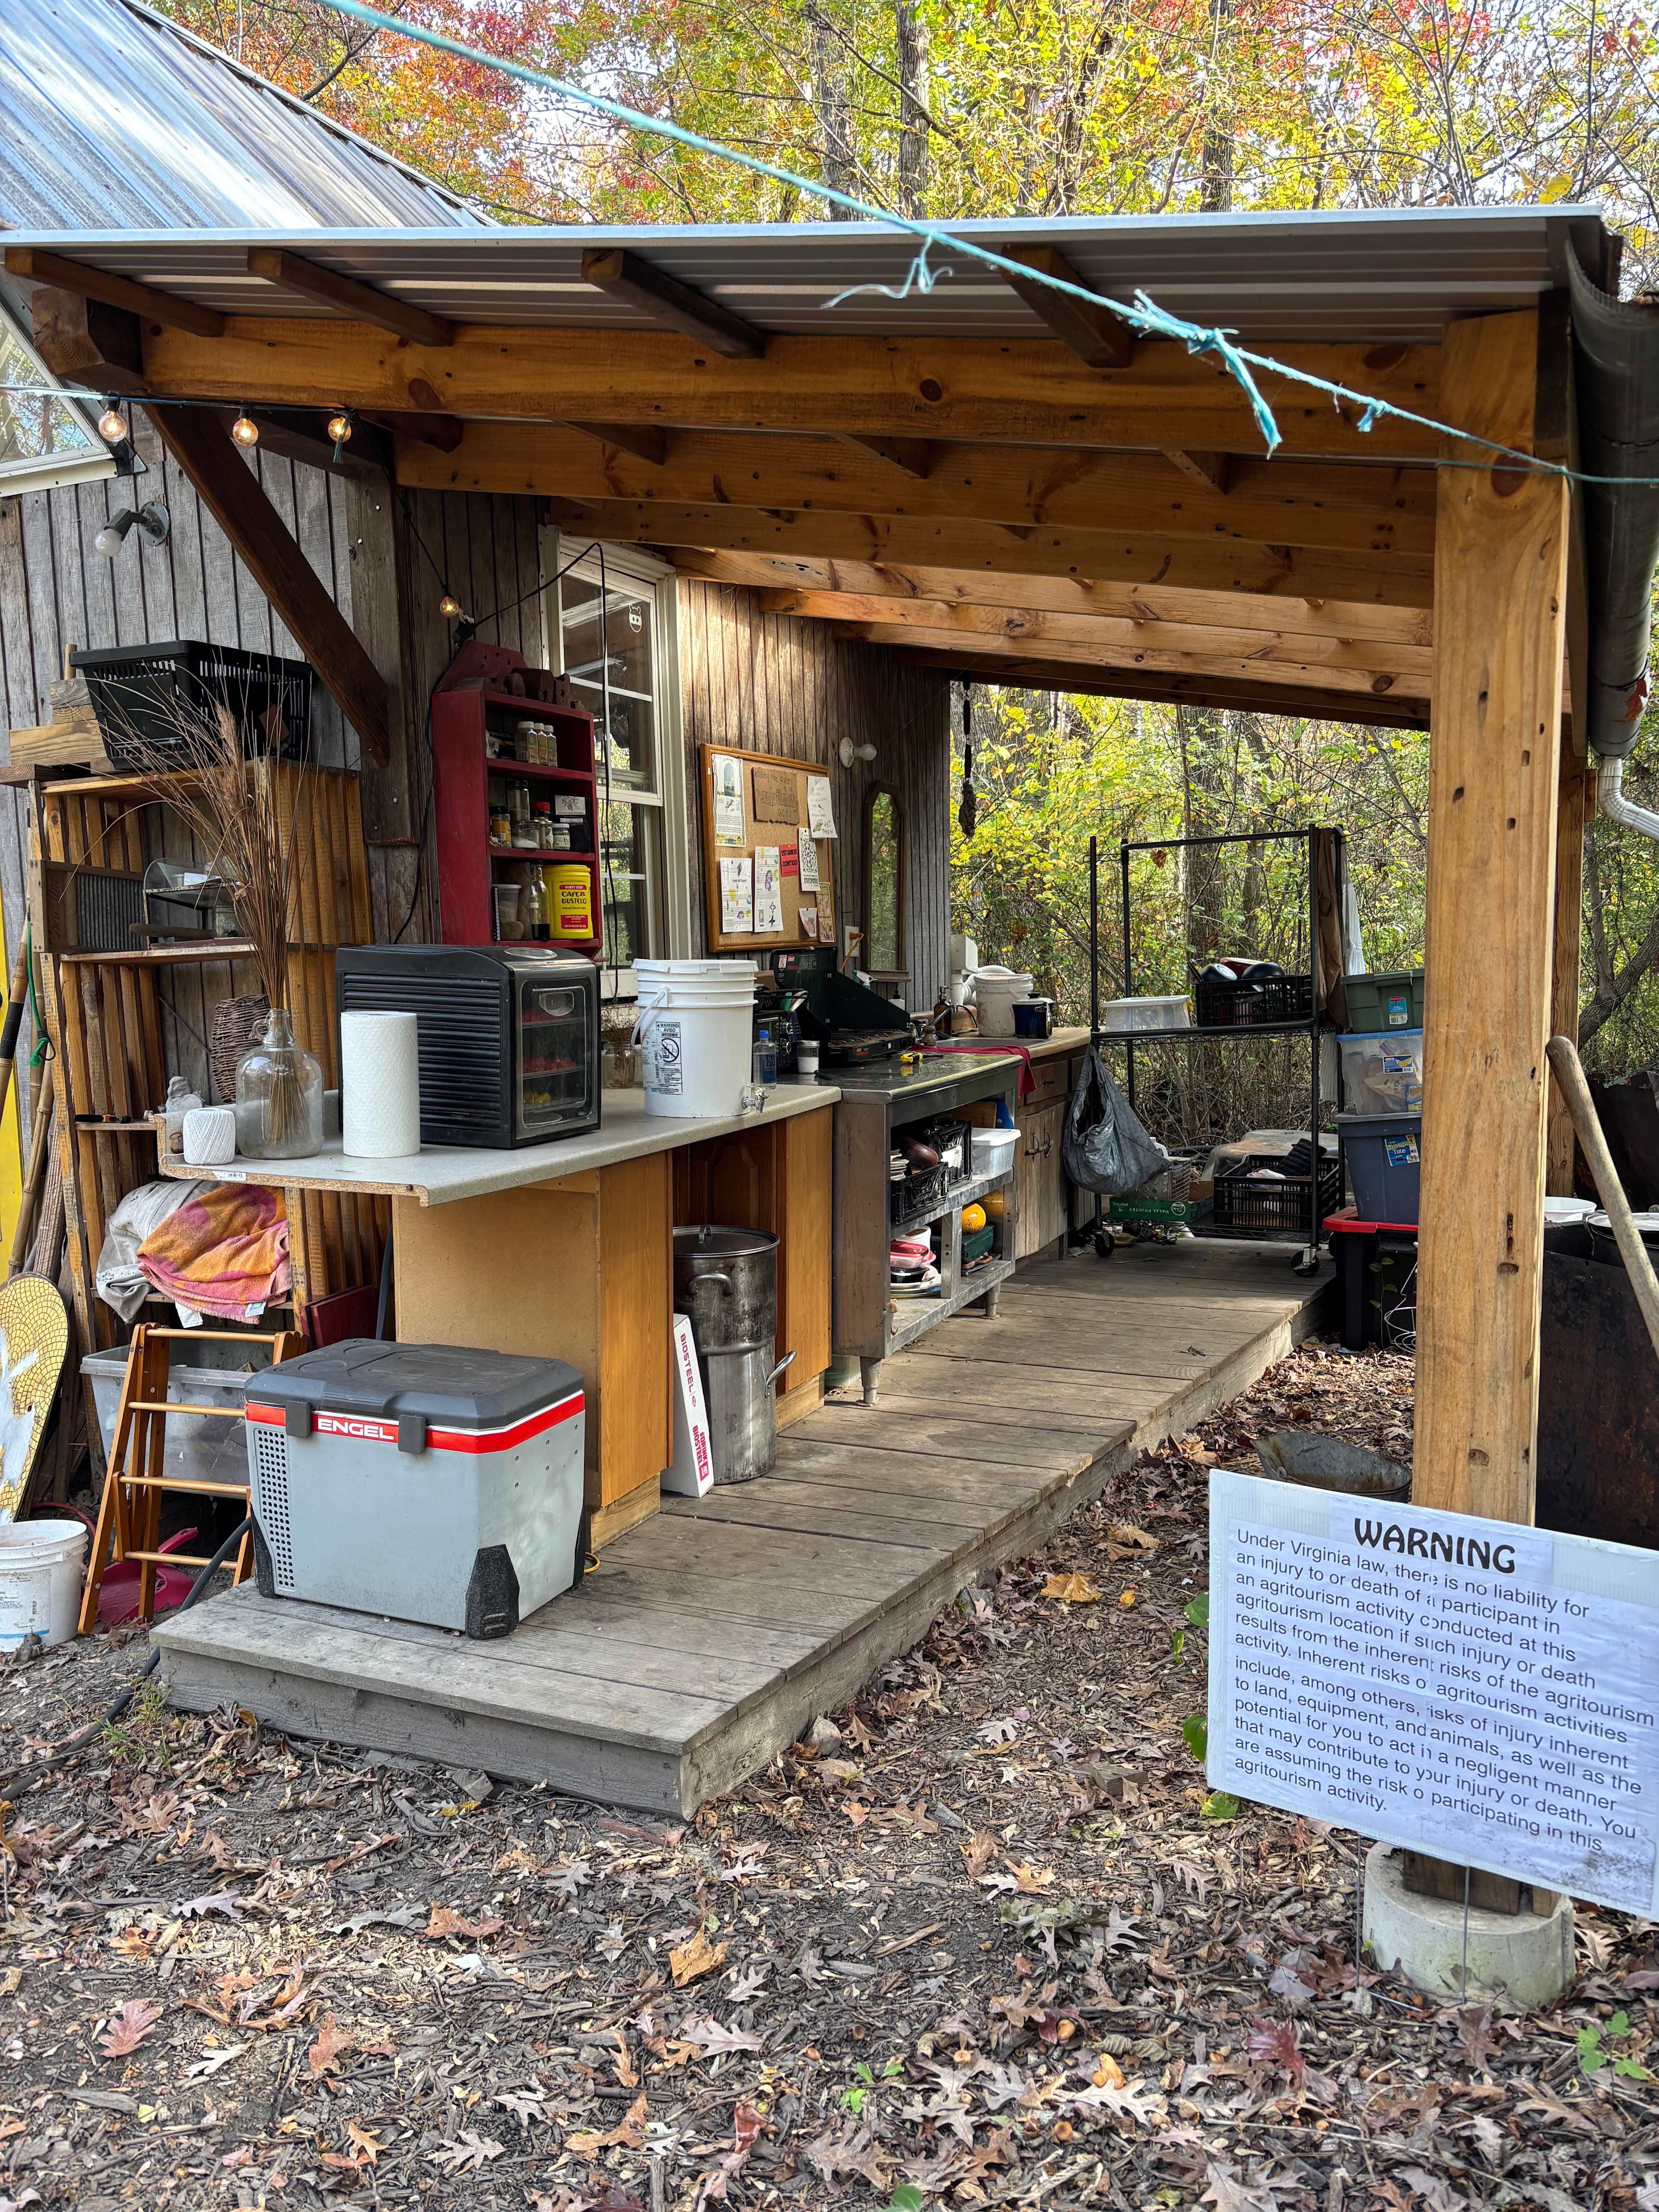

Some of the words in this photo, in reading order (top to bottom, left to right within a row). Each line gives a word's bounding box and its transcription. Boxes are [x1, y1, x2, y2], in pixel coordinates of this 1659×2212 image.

[680, 1333, 694, 1393] BIOSTEEL
[318, 1417, 394, 1440] ENGEL
[693, 1424, 702, 1467] BIOSTEEL
[699, 1432, 708, 1462] #DRINK
[1238, 1529, 1285, 1551] Under
[1290, 1540, 1351, 1567] Virginia
[1357, 1554, 1388, 1577] law,
[1445, 1573, 1458, 1590] is
[1465, 1581, 1487, 1595] no
[1494, 1584, 1558, 1614] liability
[1564, 1599, 1589, 1618] for
[1354, 1517, 1516, 1574] WARNING
[1236, 1553, 1255, 1566] an
[1261, 1554, 1303, 1580] injury
[1308, 1566, 1324, 1581] to
[1329, 1573, 1346, 1586] or
[1351, 1576, 1398, 1598] death
[1405, 1589, 1421, 1602] of
[1442, 1599, 1538, 1630] participant
[1545, 1617, 1560, 1635] in
[1236, 1573, 1254, 1587] an
[1260, 1579, 1350, 1608] agritourism
[1356, 1601, 1414, 1626] activity
[1519, 1638, 1537, 1652] at
[1542, 1641, 1576, 1662] this
[1236, 1593, 1323, 1623] agritourism
[1329, 1611, 1393, 1640] location
[1400, 1628, 1409, 1643] if
[1414, 1636, 1455, 1655] such
[1462, 1643, 1511, 1671] injury
[1517, 1660, 1536, 1674] or
[1541, 1665, 1595, 1689] death
[1236, 1613, 1287, 1634] results
[1291, 1624, 1327, 1645] from
[1333, 1635, 1359, 1652] the
[1440, 1661, 1481, 1682] risks
[1487, 1674, 1505, 1689] of
[1510, 1678, 1538, 1698] the
[1545, 1691, 1653, 1726] agritourism
[1235, 1634, 1291, 1657] activity.
[1298, 1646, 1365, 1675] Inherent
[1371, 1665, 1410, 1685] risks
[1416, 1678, 1428, 1689] o
[1437, 1684, 1537, 1719] agritourism
[1544, 1713, 1628, 1743] activities
[1236, 1655, 1295, 1685] include,
[1301, 1675, 1355, 1702] among
[1362, 1691, 1419, 1717] others,
[1427, 1705, 1464, 1725] isks
[1470, 1718, 1487, 1731] of
[1494, 1720, 1544, 1749] injury
[1550, 1735, 1630, 1769] inherent
[1234, 1716, 1264, 1735] that
[1269, 1727, 1303, 1748] may
[1307, 1738, 1389, 1769] contribute
[1394, 1759, 1410, 1774] to
[1457, 1774, 1505, 1803] injury
[1511, 1794, 1529, 1807] or
[1535, 1798, 1592, 1827] death.
[1600, 1816, 1636, 1839] You
[1235, 1676, 1249, 1691] to
[1255, 1680, 1291, 1704] land,
[1297, 1695, 1388, 1729] equipment,
[1395, 1720, 1426, 1737] and
[1430, 1728, 1503, 1760] animals,
[1511, 1751, 1532, 1765] as
[1539, 1758, 1576, 1777] well
[1582, 1769, 1605, 1785] as
[1611, 1773, 1642, 1794] the
[1235, 1698, 1301, 1724] potential
[1306, 1714, 1328, 1732] for
[1332, 1724, 1361, 1742] you
[1367, 1732, 1383, 1747] to
[1389, 1739, 1416, 1755] act
[1438, 1752, 1449, 1764] a
[1455, 1756, 1538, 1789] negligent
[1545, 1781, 1618, 1811] manner
[1235, 1758, 1321, 1792] agritourism
[1327, 1784, 1387, 1812] activity.
[1235, 1738, 1259, 1753] are
[1265, 1747, 1341, 1780] assuming
[1346, 1767, 1372, 1785] the
[1379, 1776, 1408, 1796] risk
[1432, 1792, 1540, 1836] participating
[1545, 1822, 1562, 1840] in
[1569, 1830, 1602, 1851] this
